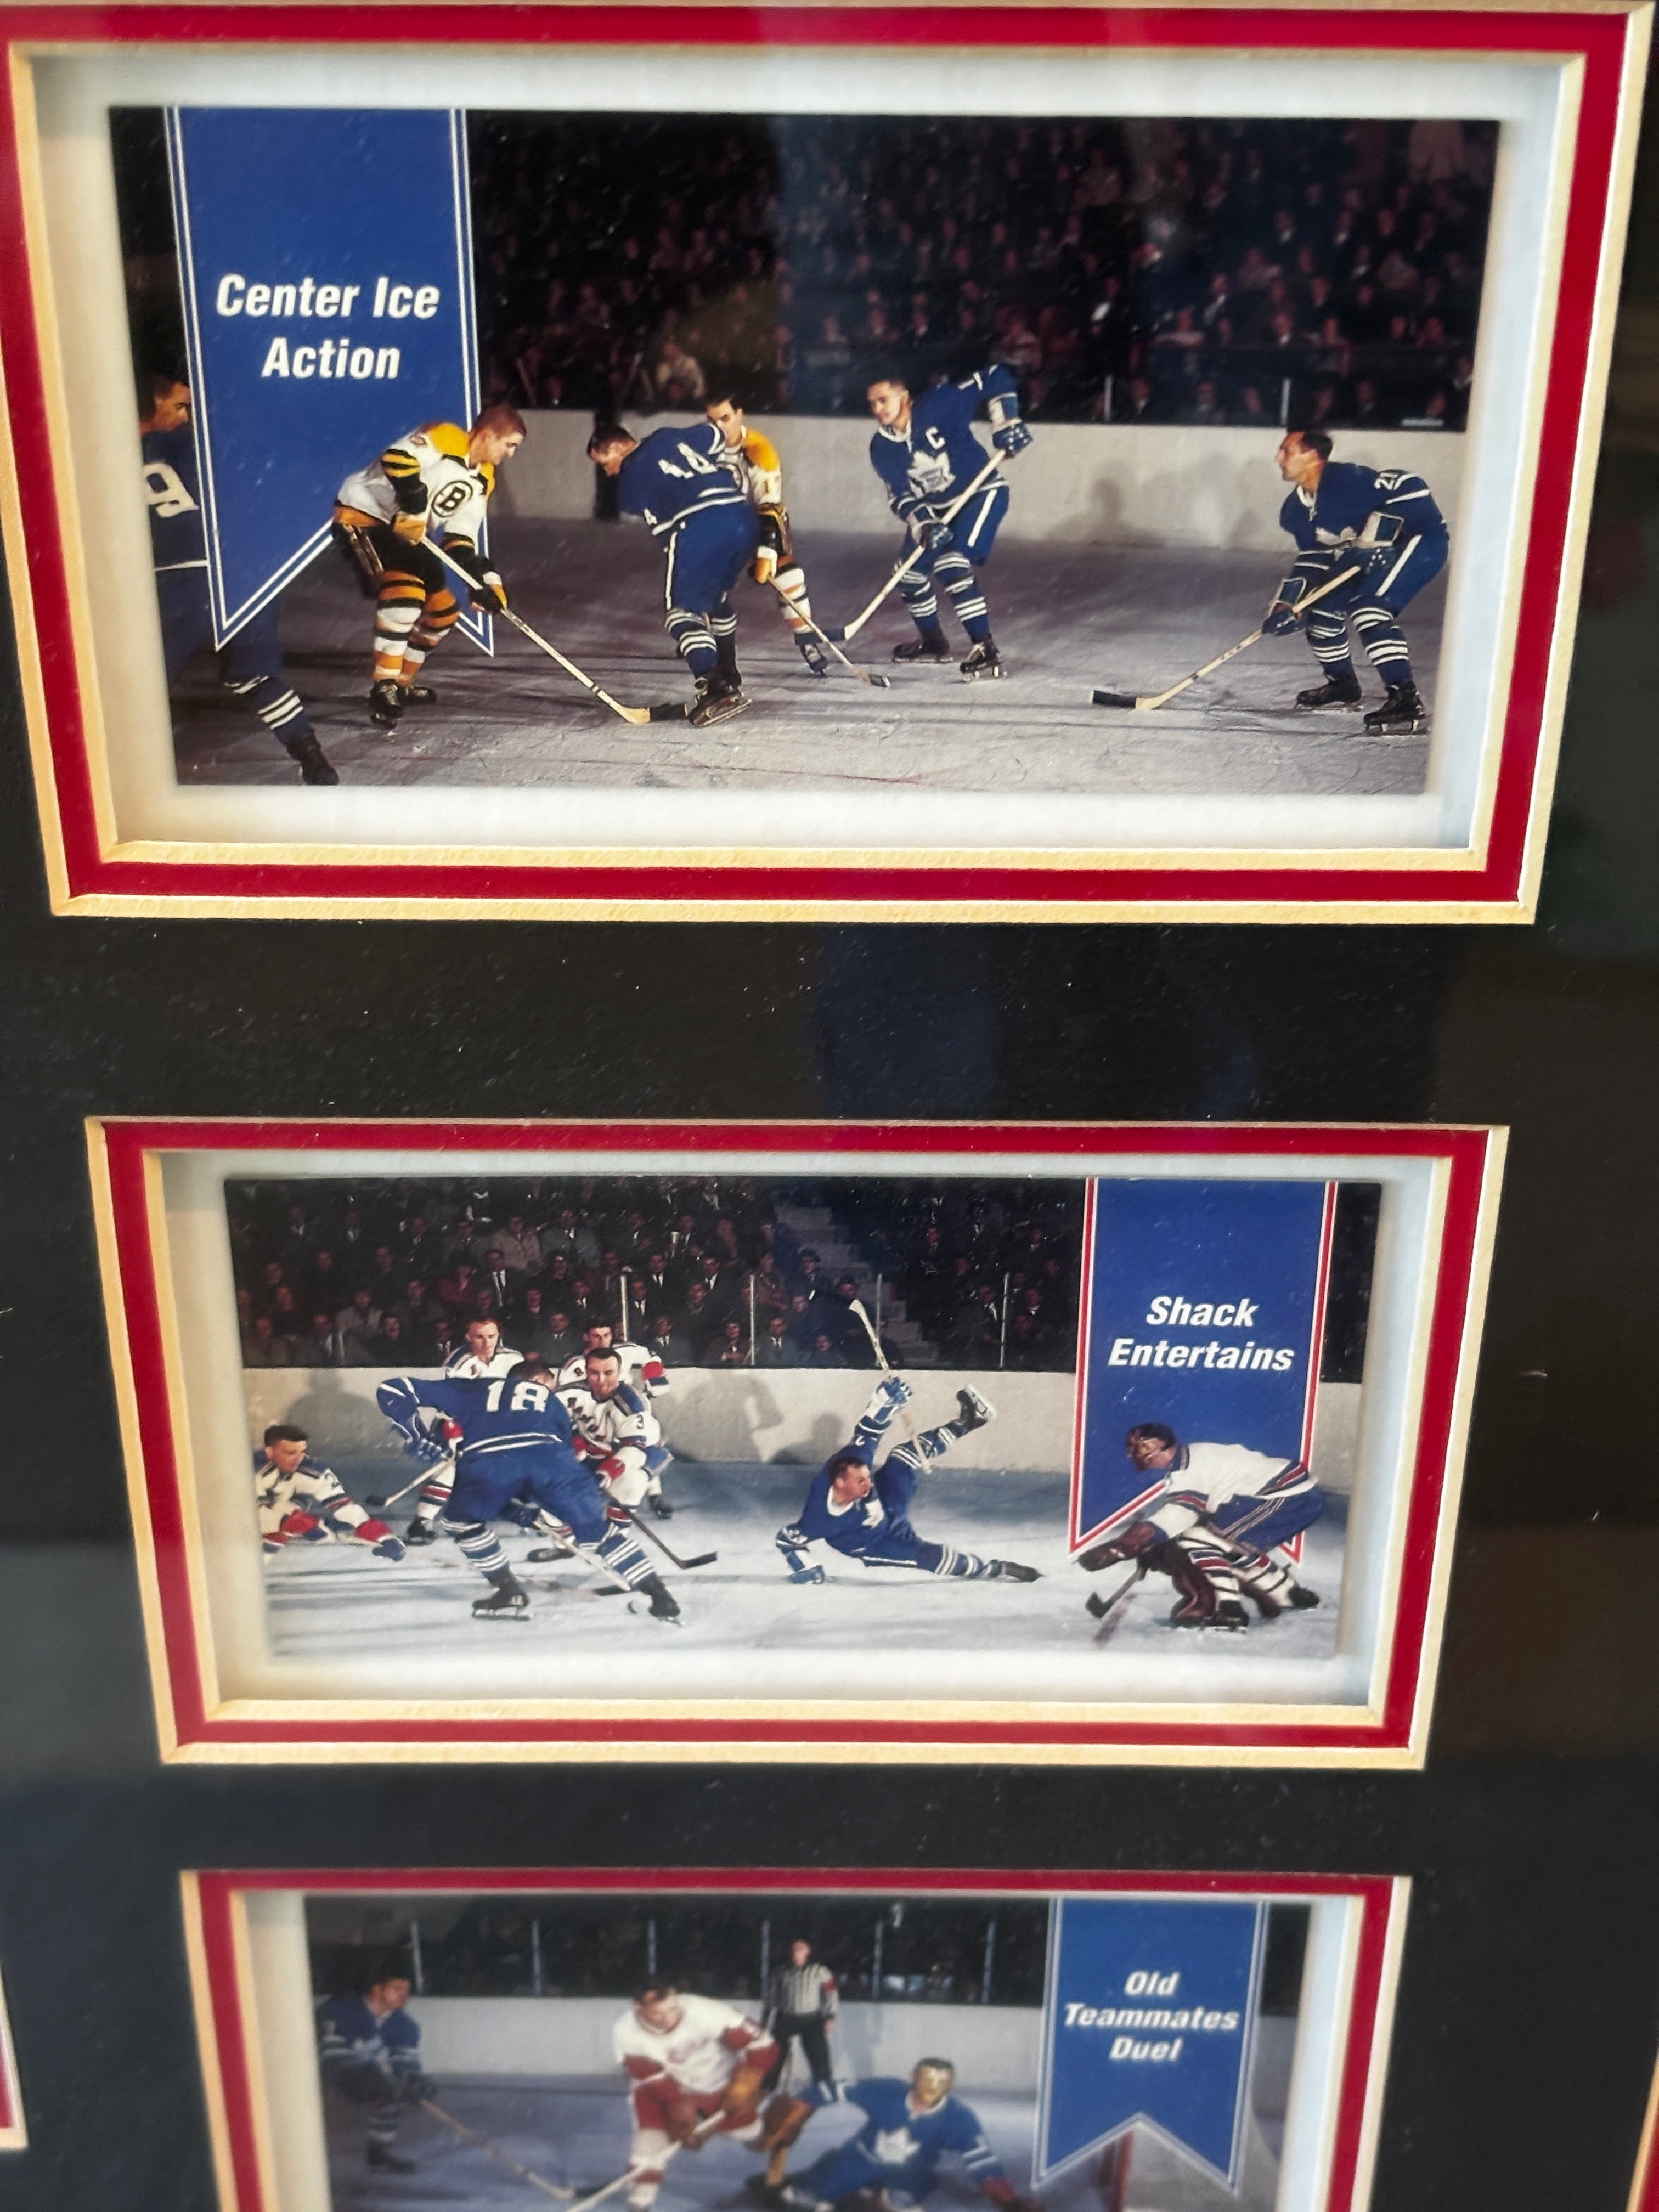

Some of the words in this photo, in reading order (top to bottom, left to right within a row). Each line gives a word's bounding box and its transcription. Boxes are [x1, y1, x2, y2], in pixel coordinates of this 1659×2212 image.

[217, 274, 359, 318] Center
[372, 276, 440, 319] Ice
[261, 337, 401, 380] Action
[925, 427, 945, 450] C
[1146, 1295, 1260, 1327] Shack
[1107, 1338, 1295, 1372] Entertains
[485, 1381, 550, 1413] 18
[1124, 1970, 1181, 1996] Old
[1064, 2002, 1240, 2031] Teammates
[1108, 2036, 1184, 2061] Duel
